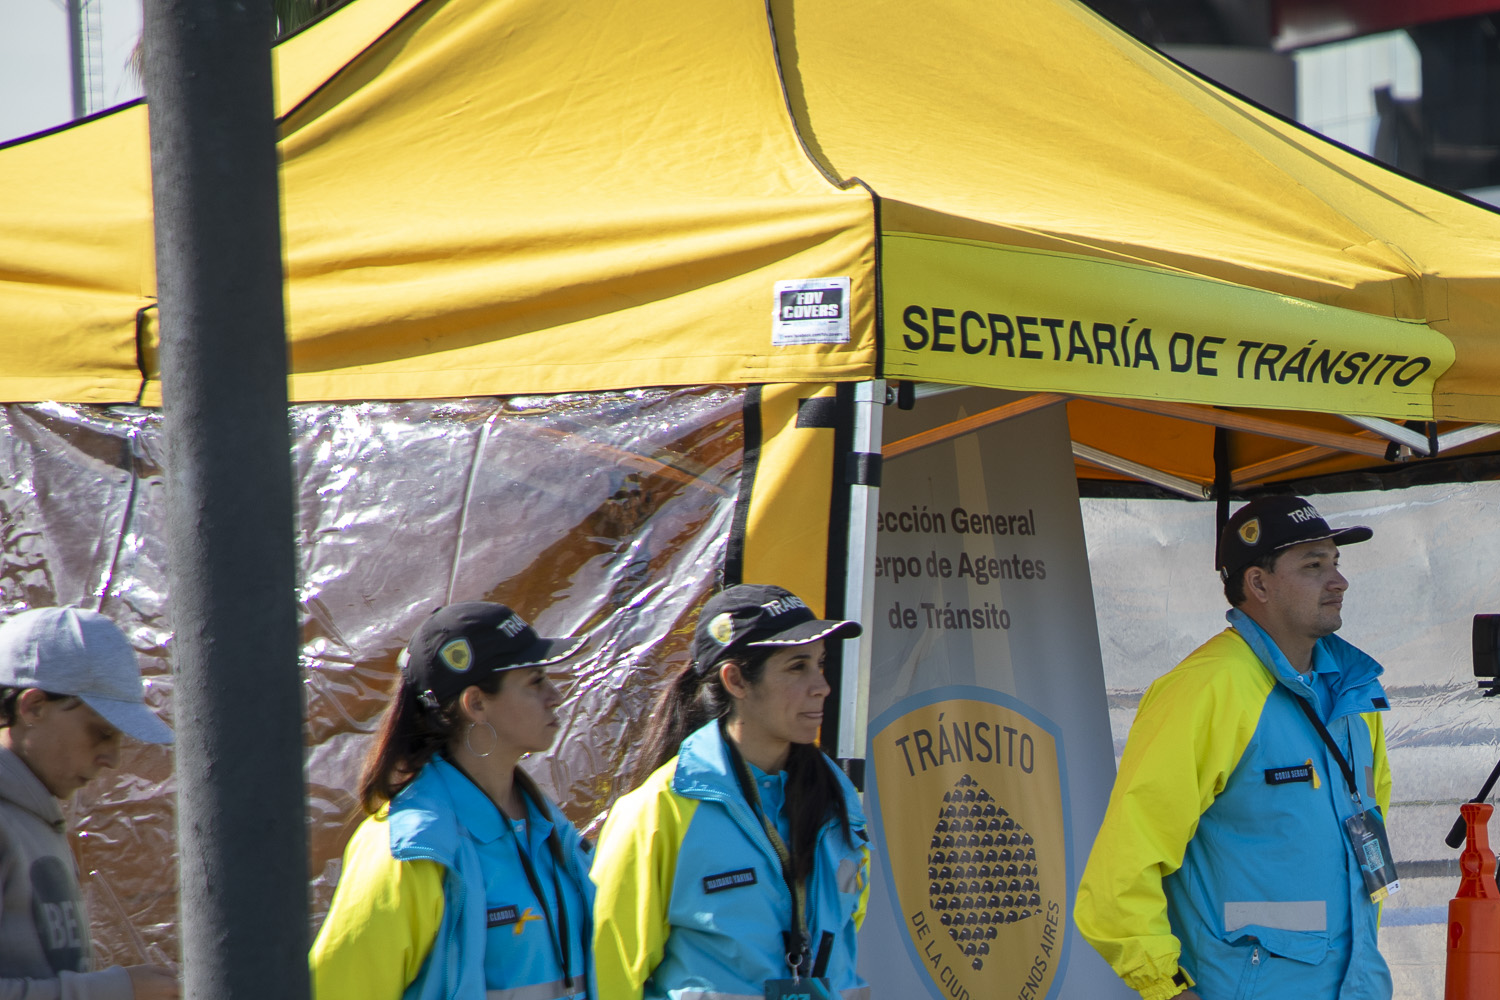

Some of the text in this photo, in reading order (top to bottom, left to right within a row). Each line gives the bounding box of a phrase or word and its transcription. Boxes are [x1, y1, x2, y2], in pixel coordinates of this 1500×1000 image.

[782, 304, 839, 319] COVERS
[796, 291, 824, 305] FDV
[901, 303, 1432, 389] SECRETARÍA DE TRÁNSITO
[951, 507, 1036, 536] General
[926, 551, 953, 578] de
[957, 552, 1047, 585] Agentes
[888, 602, 1011, 631] de Tránsito
[895, 712, 1035, 777] TRÁNSITO
[910, 909, 932, 944] DE
[924, 943, 942, 970] LA
[1042, 901, 1060, 961] AIRES
